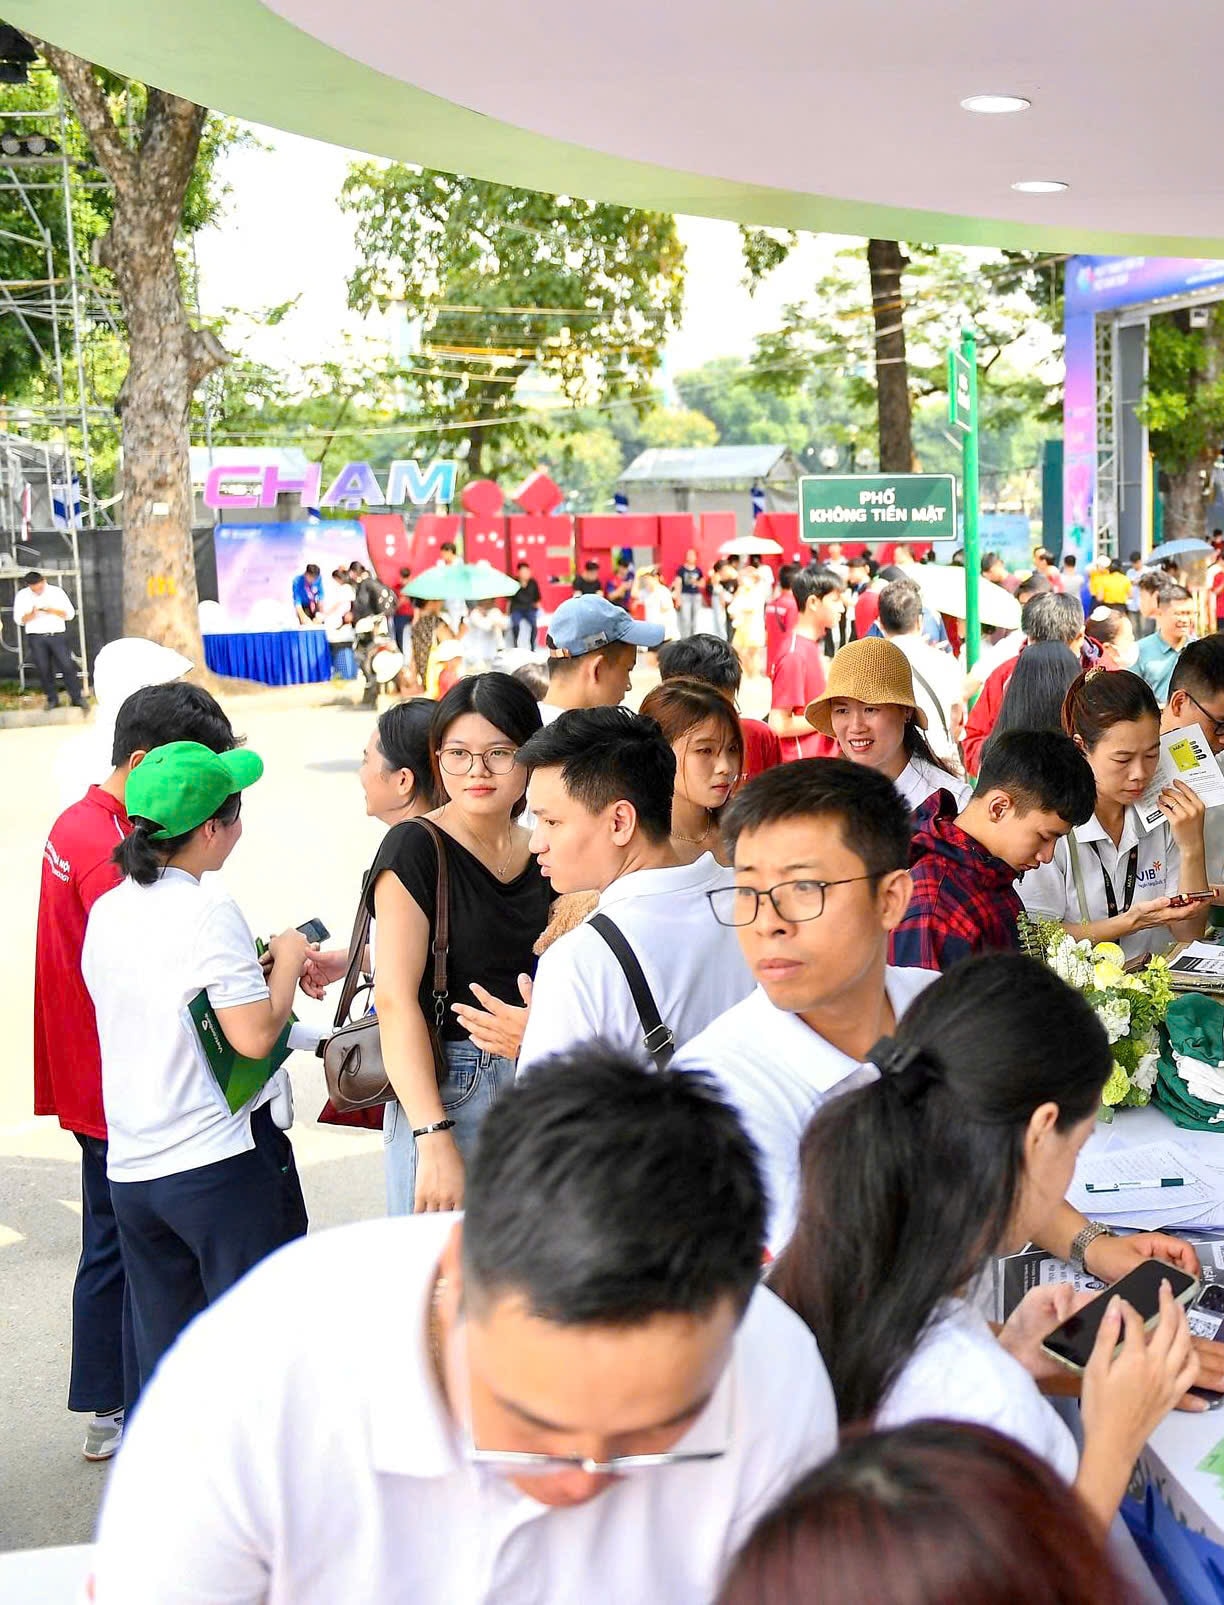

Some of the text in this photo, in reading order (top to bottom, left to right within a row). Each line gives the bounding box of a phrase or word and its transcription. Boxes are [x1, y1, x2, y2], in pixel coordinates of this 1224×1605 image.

[859, 487, 896, 505] PHỐ
[809, 505, 867, 523] KHÔNG
[911, 504, 946, 524] MẶT
[1135, 869, 1156, 882] VIB
